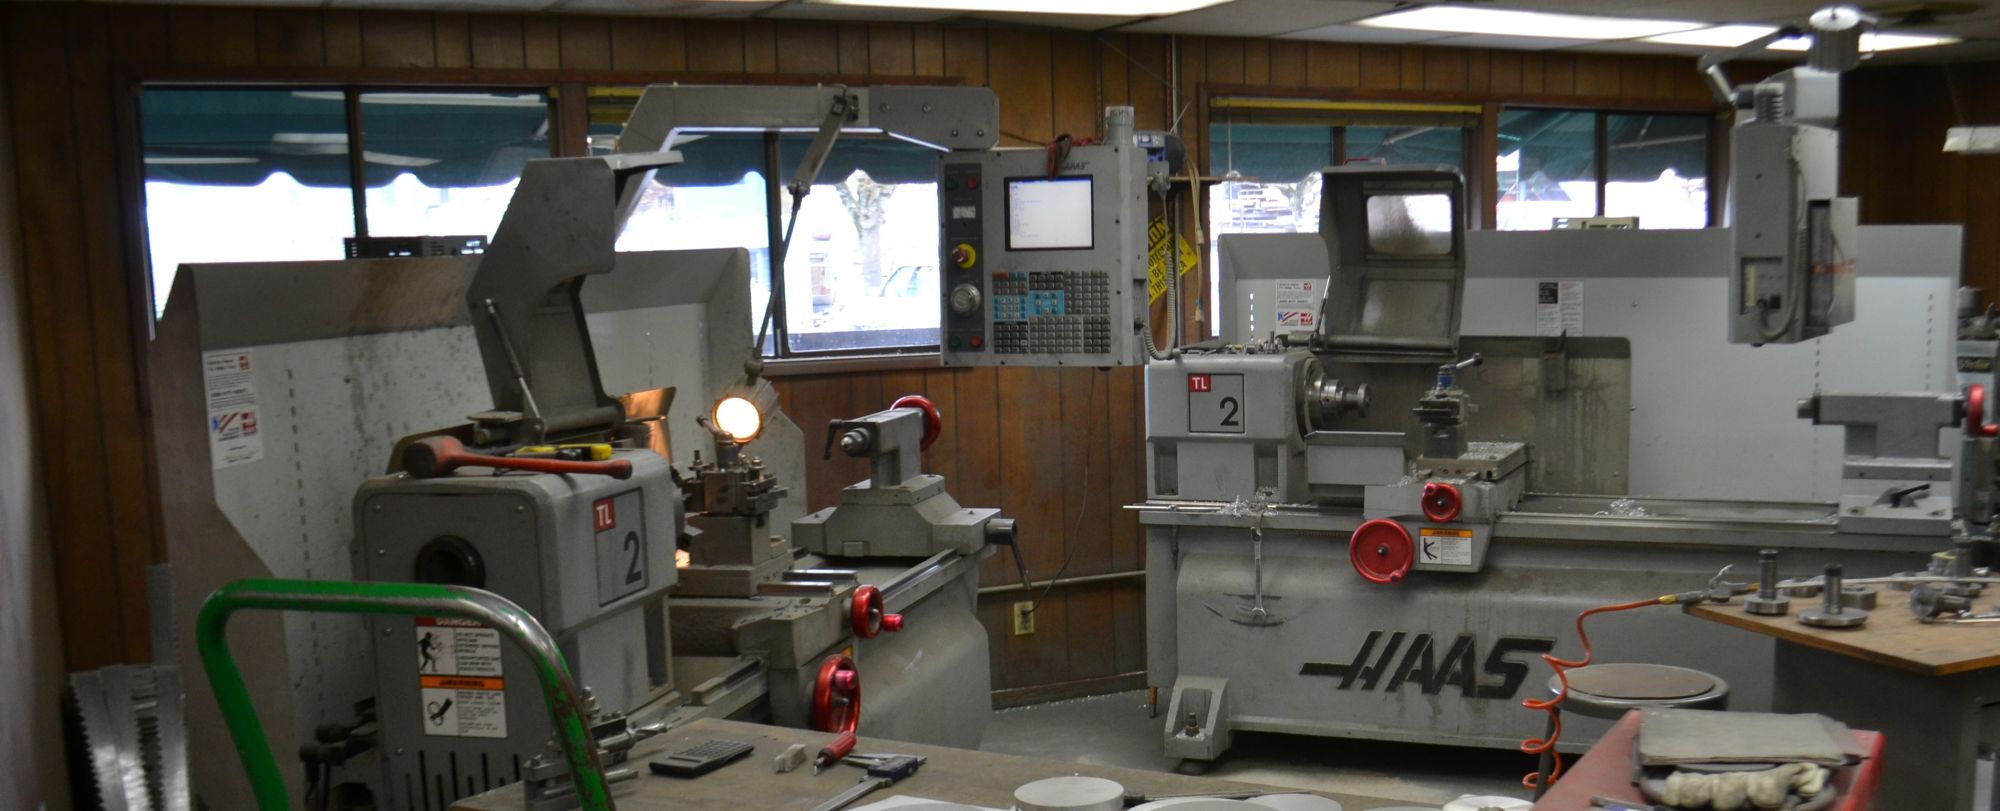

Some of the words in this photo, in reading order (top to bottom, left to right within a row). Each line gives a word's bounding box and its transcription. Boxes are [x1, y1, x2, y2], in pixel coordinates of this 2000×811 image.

[1191, 376, 1207, 390] TL
[1219, 396, 1239, 426] 2
[596, 503, 613, 527] TL
[623, 530, 643, 585] 2
[1299, 630, 1557, 699] HAAS
